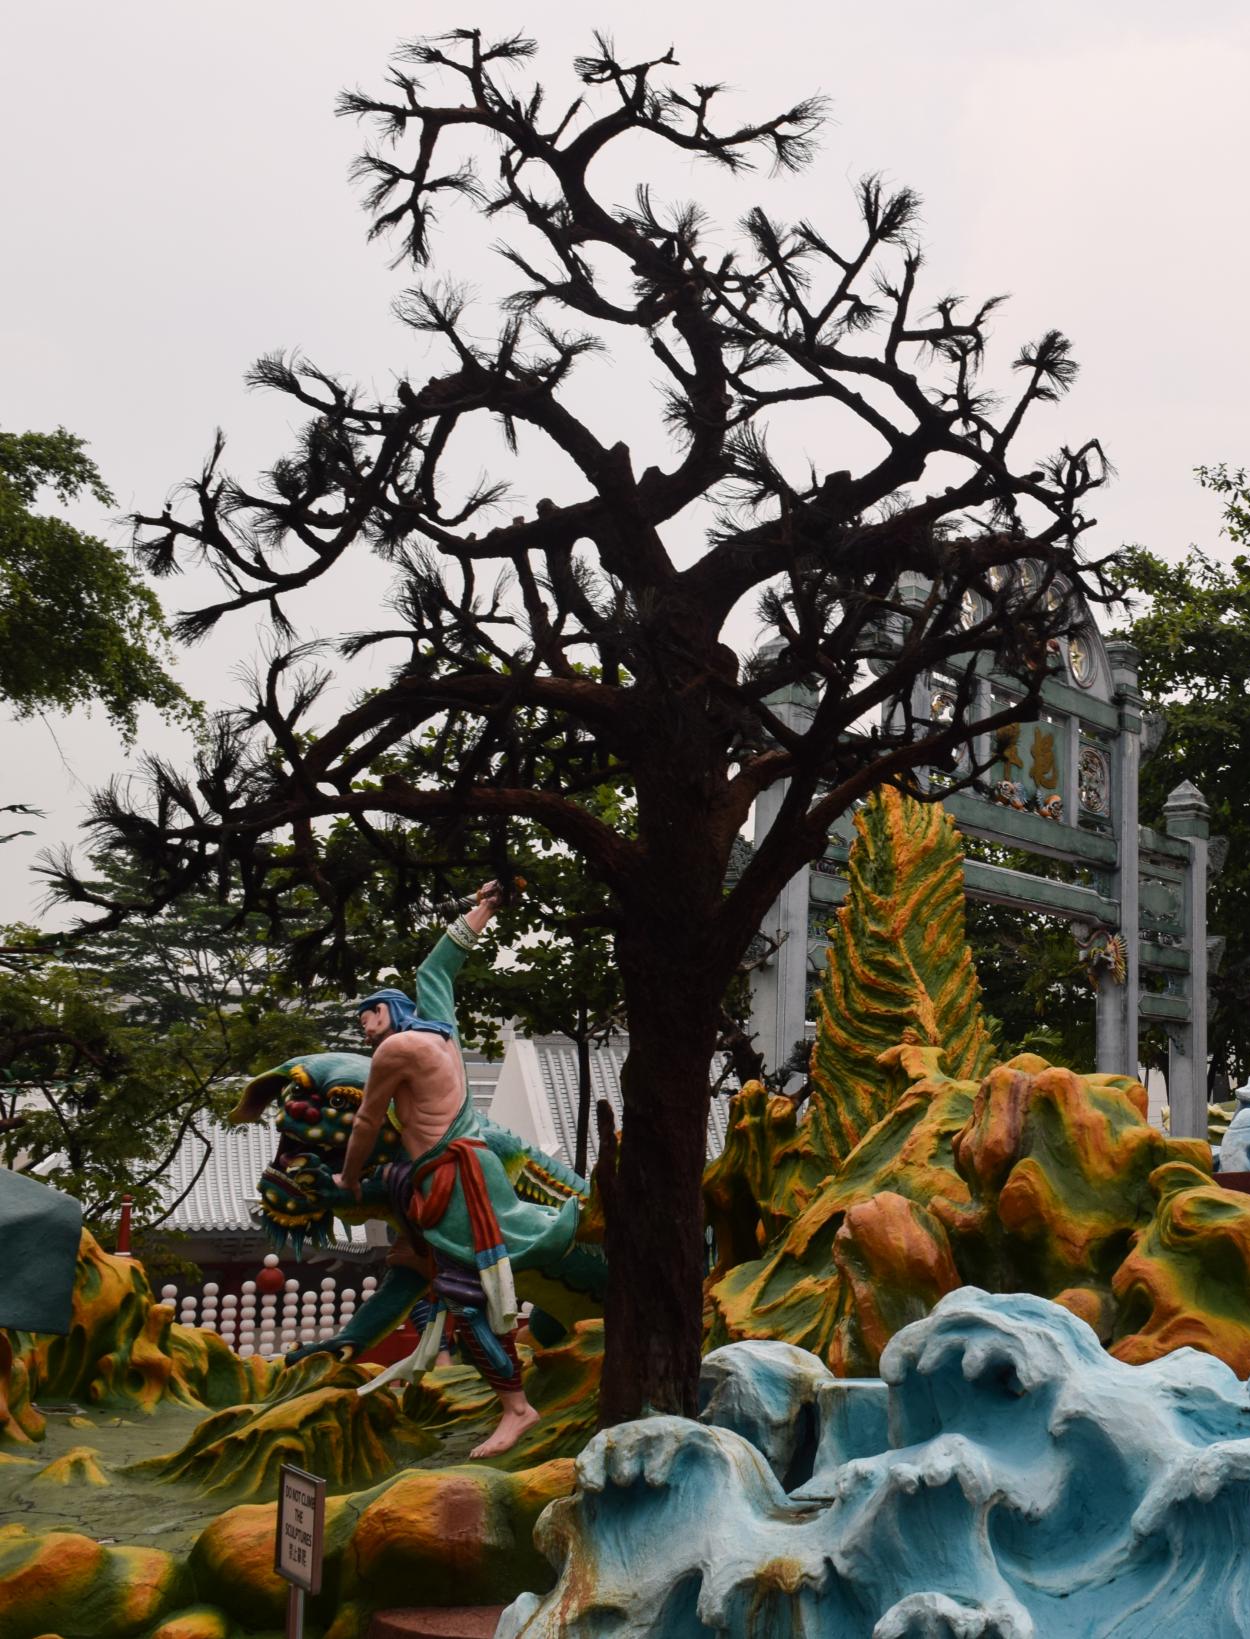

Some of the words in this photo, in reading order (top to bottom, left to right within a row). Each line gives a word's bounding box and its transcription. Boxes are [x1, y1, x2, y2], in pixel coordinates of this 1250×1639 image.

[285, 1485, 292, 1497] DO
[292, 1488, 301, 1504] NOT
[301, 1492, 315, 1510] CLIMB
[294, 1508, 303, 1524] THE
[285, 1522, 312, 1548] SCULPTURES
